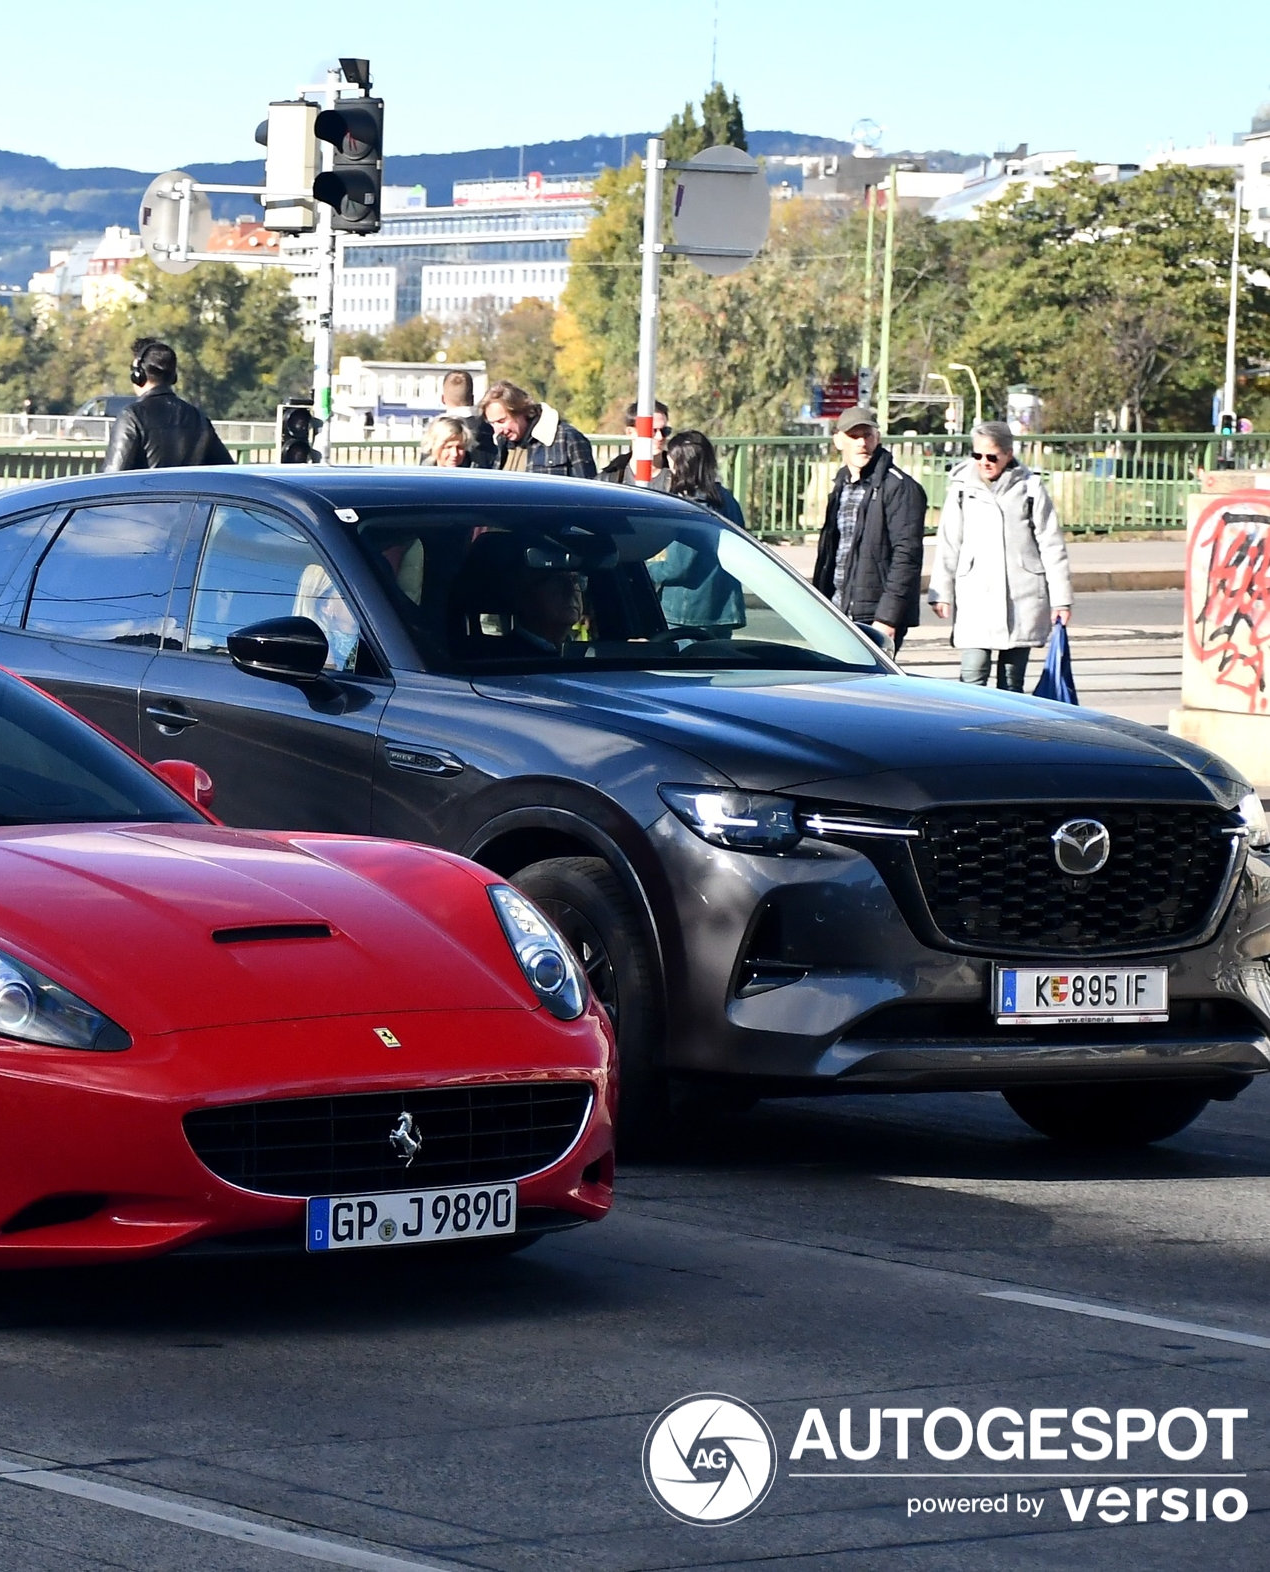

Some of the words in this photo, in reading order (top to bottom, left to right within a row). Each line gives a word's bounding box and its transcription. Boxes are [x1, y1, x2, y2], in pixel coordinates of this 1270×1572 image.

[1035, 975, 1050, 1007] K
[1072, 974, 1117, 1007] 895
[1005, 997, 1013, 1007] A
[1058, 1016, 1115, 1024] www.eisner.at
[332, 1200, 378, 1242] GP
[402, 1197, 424, 1237] J
[432, 1189, 511, 1235] 9890
[314, 1229, 323, 1241] D
